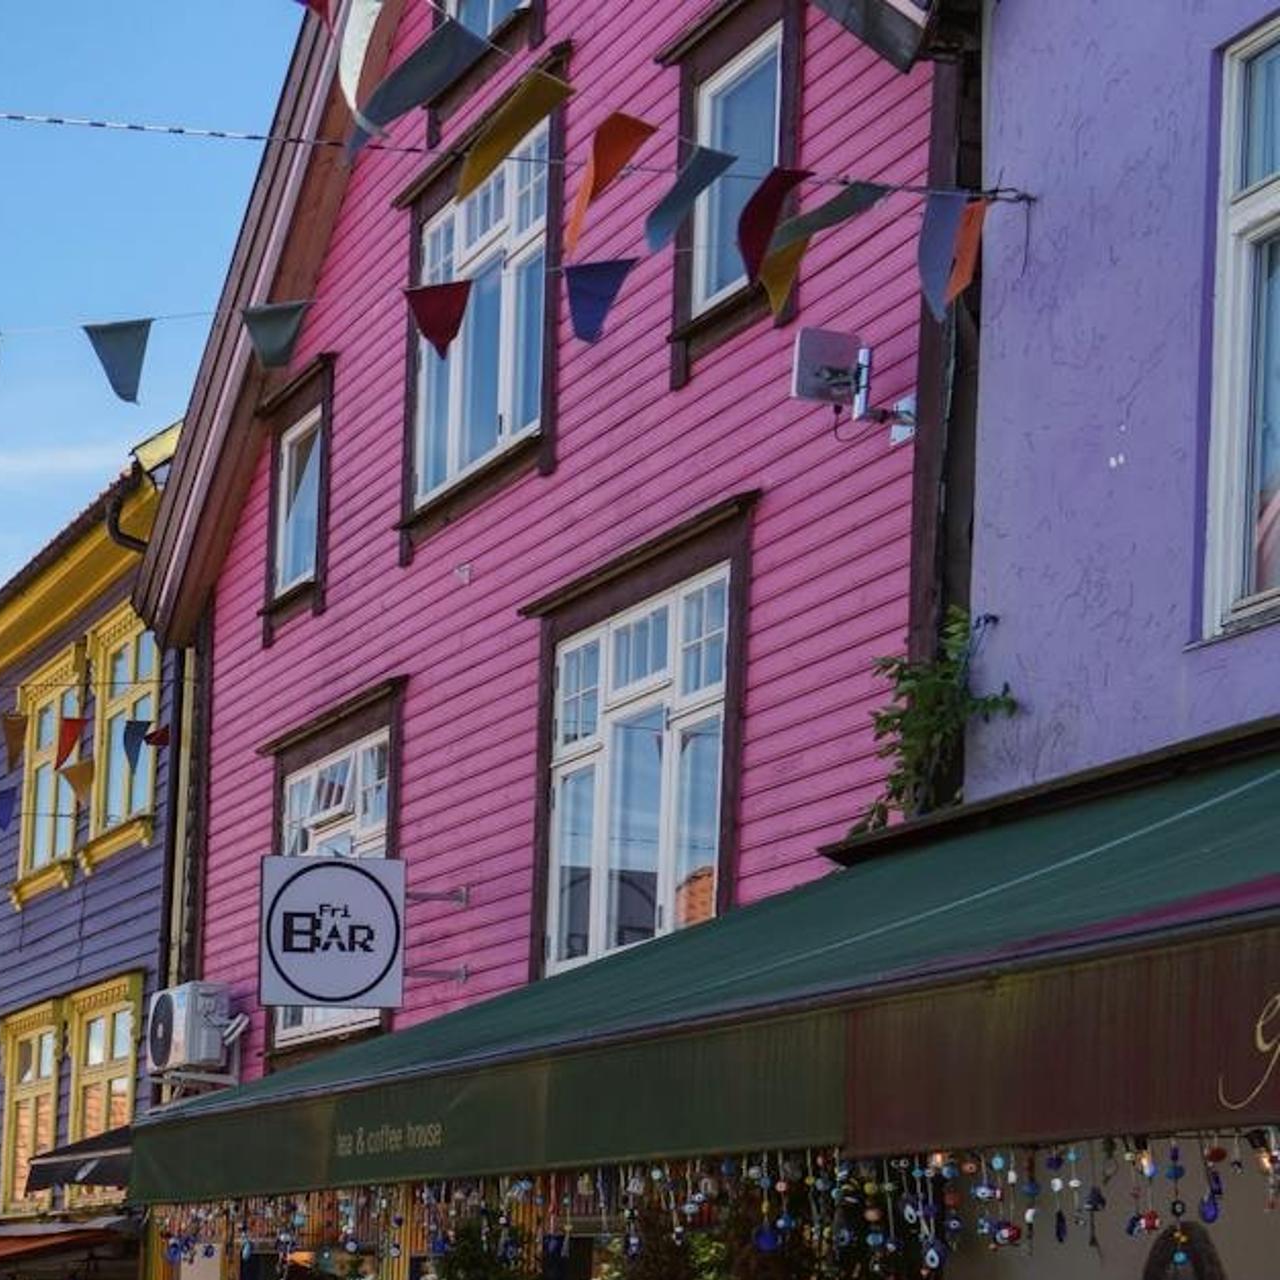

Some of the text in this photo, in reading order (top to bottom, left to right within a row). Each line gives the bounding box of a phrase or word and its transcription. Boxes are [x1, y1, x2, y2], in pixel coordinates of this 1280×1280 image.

[318, 903, 351, 918] Fri
[283, 912, 376, 953] BAR
[356, 1127, 365, 1155] &
[367, 1124, 402, 1153] coffee
[406, 1121, 441, 1149] house
